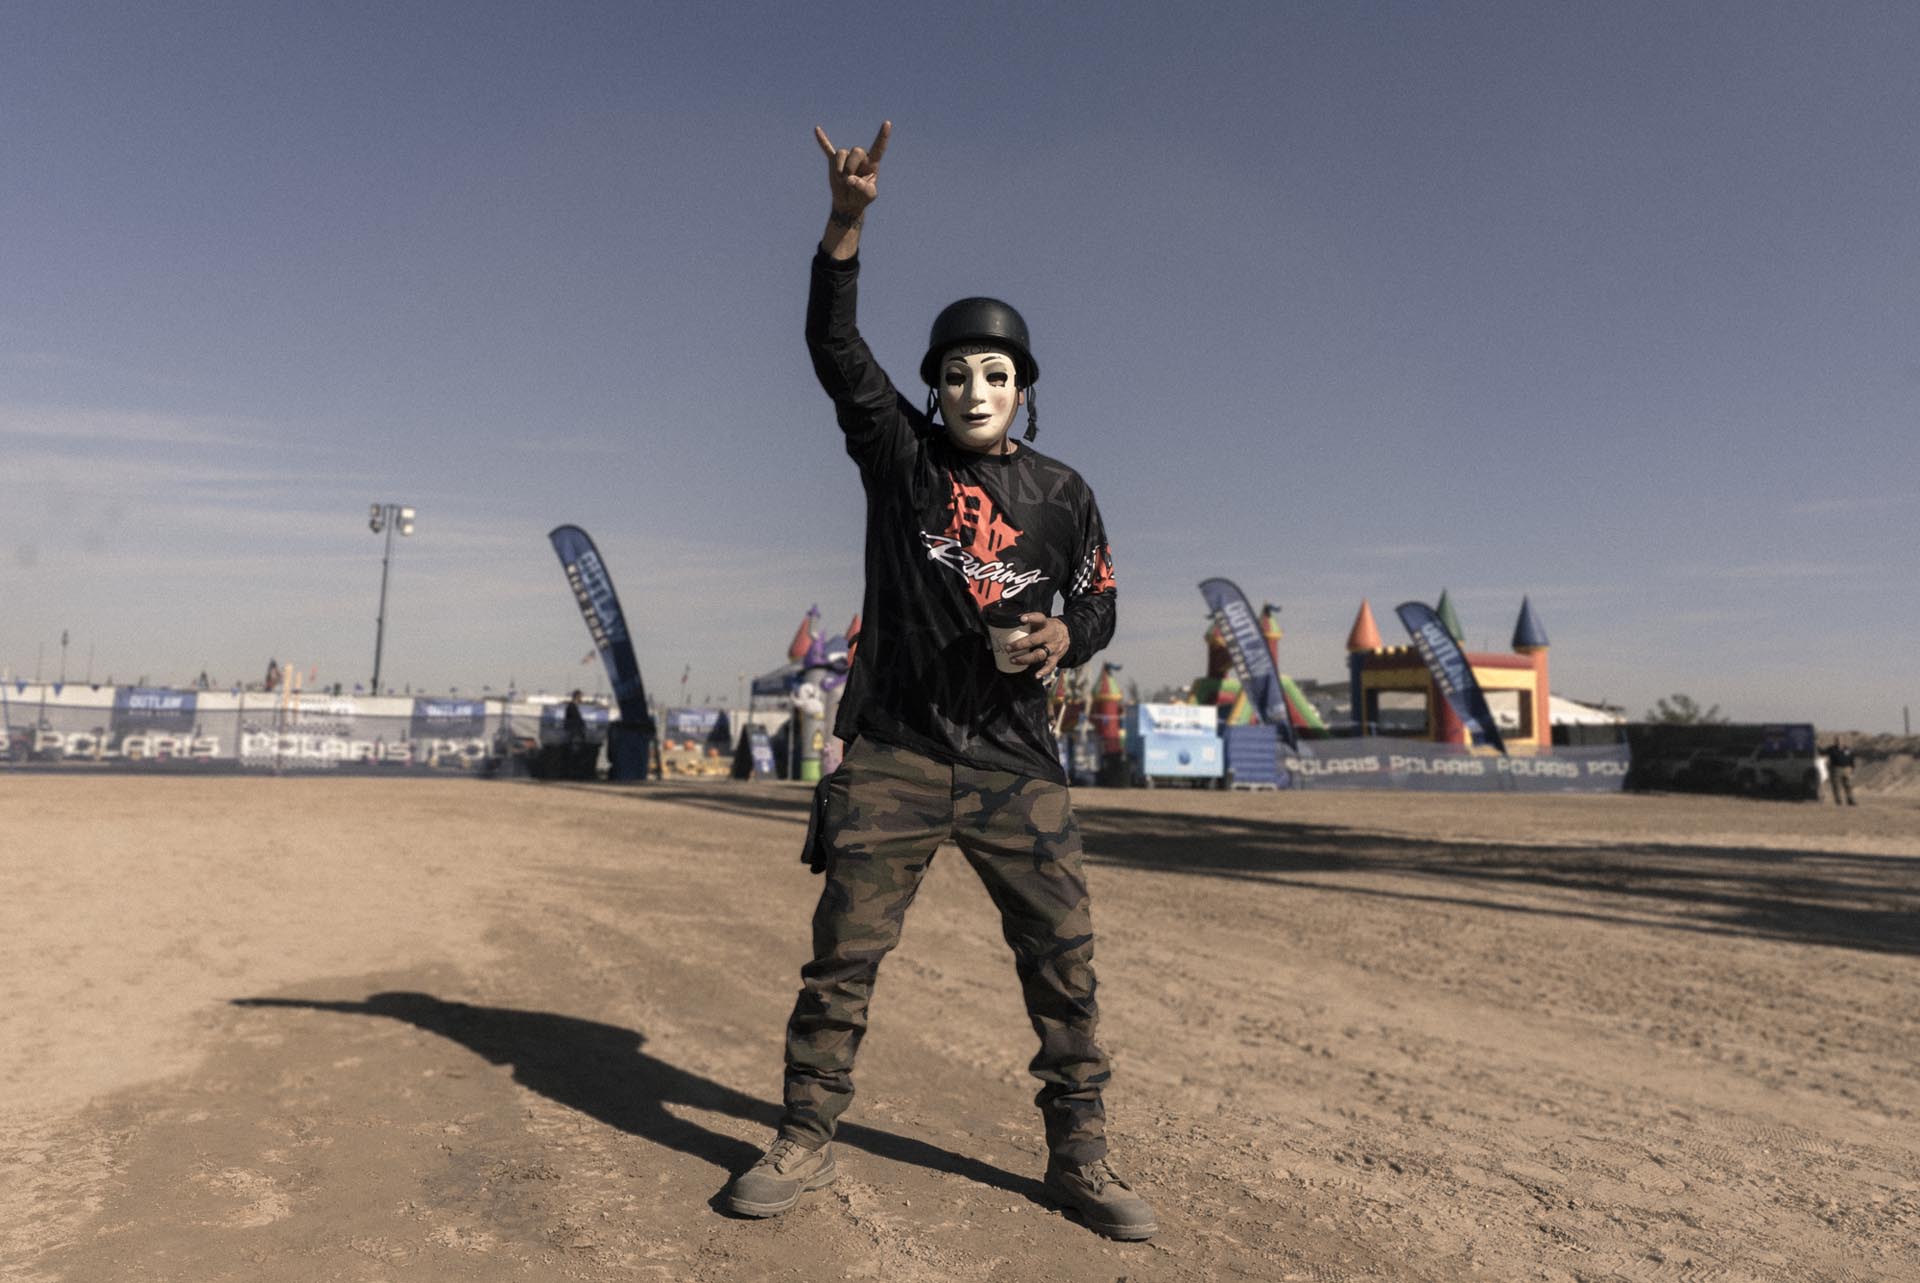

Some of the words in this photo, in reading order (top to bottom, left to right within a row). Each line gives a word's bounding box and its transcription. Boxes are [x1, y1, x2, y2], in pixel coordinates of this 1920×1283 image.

[918, 531, 1051, 599] Racing
[1224, 598, 1273, 678] OUTLAW
[129, 695, 183, 709] OUTLAW
[34, 731, 220, 758] POLARIS
[241, 734, 412, 760] POLARIS
[1285, 756, 1380, 776] POLARIS
[1389, 755, 1486, 776] POLARIS
[1496, 757, 1579, 778] POLARIS
